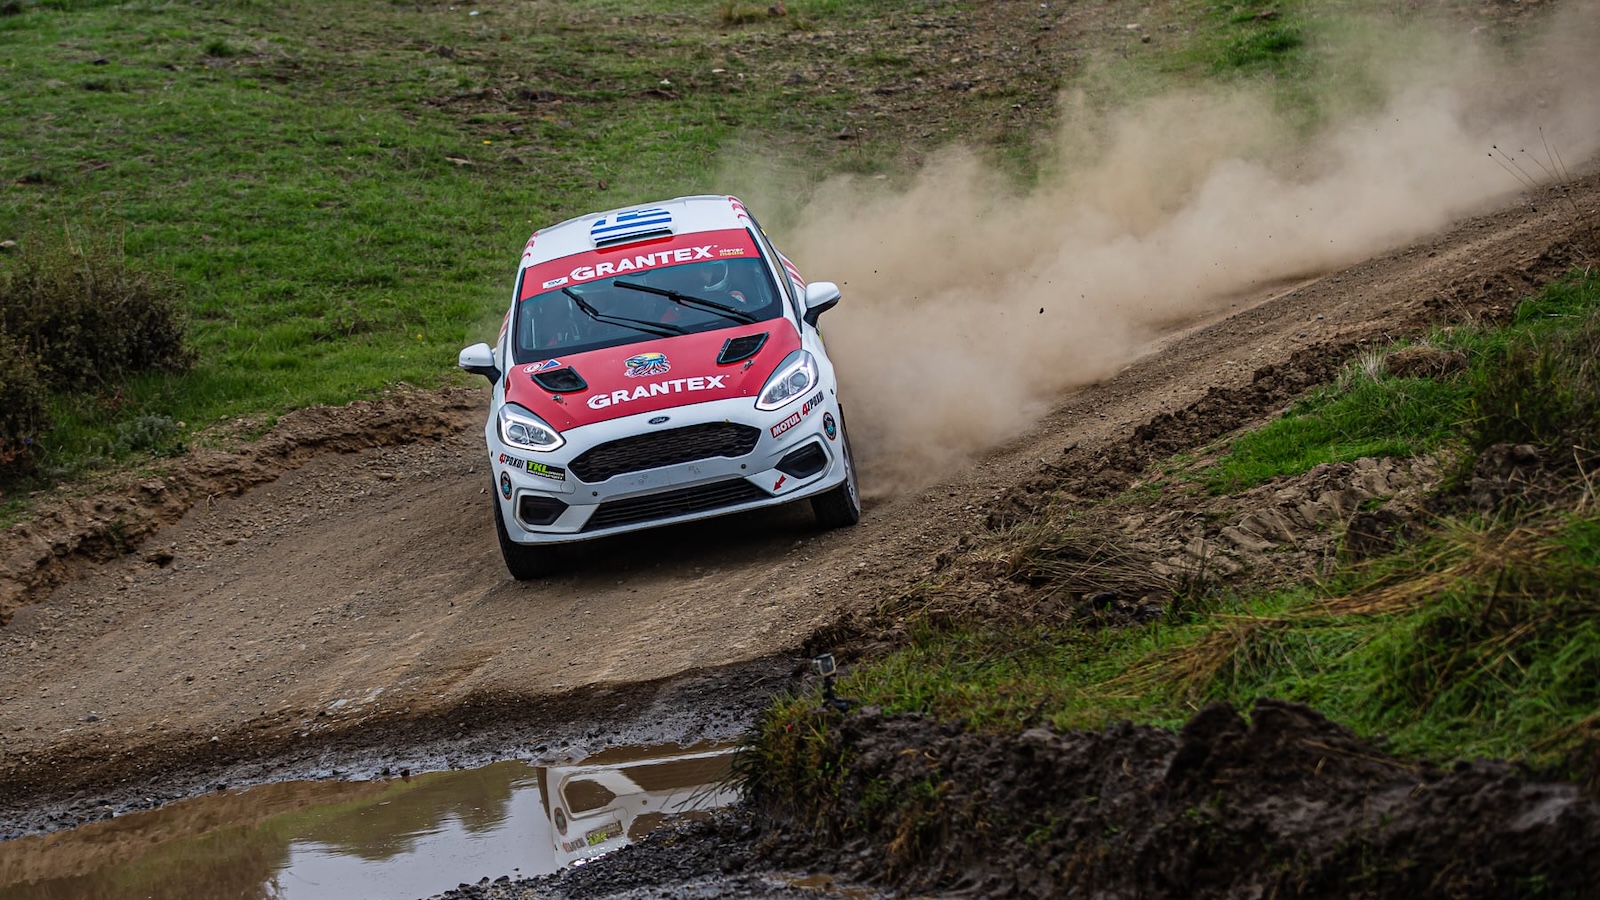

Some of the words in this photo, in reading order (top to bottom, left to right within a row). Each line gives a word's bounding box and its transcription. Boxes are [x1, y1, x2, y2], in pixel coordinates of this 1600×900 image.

[570, 245, 713, 281] GRANTEX
[586, 375, 726, 410] GRANTEX
[773, 414, 800, 437] MOTUL
[527, 461, 548, 473] TKL
